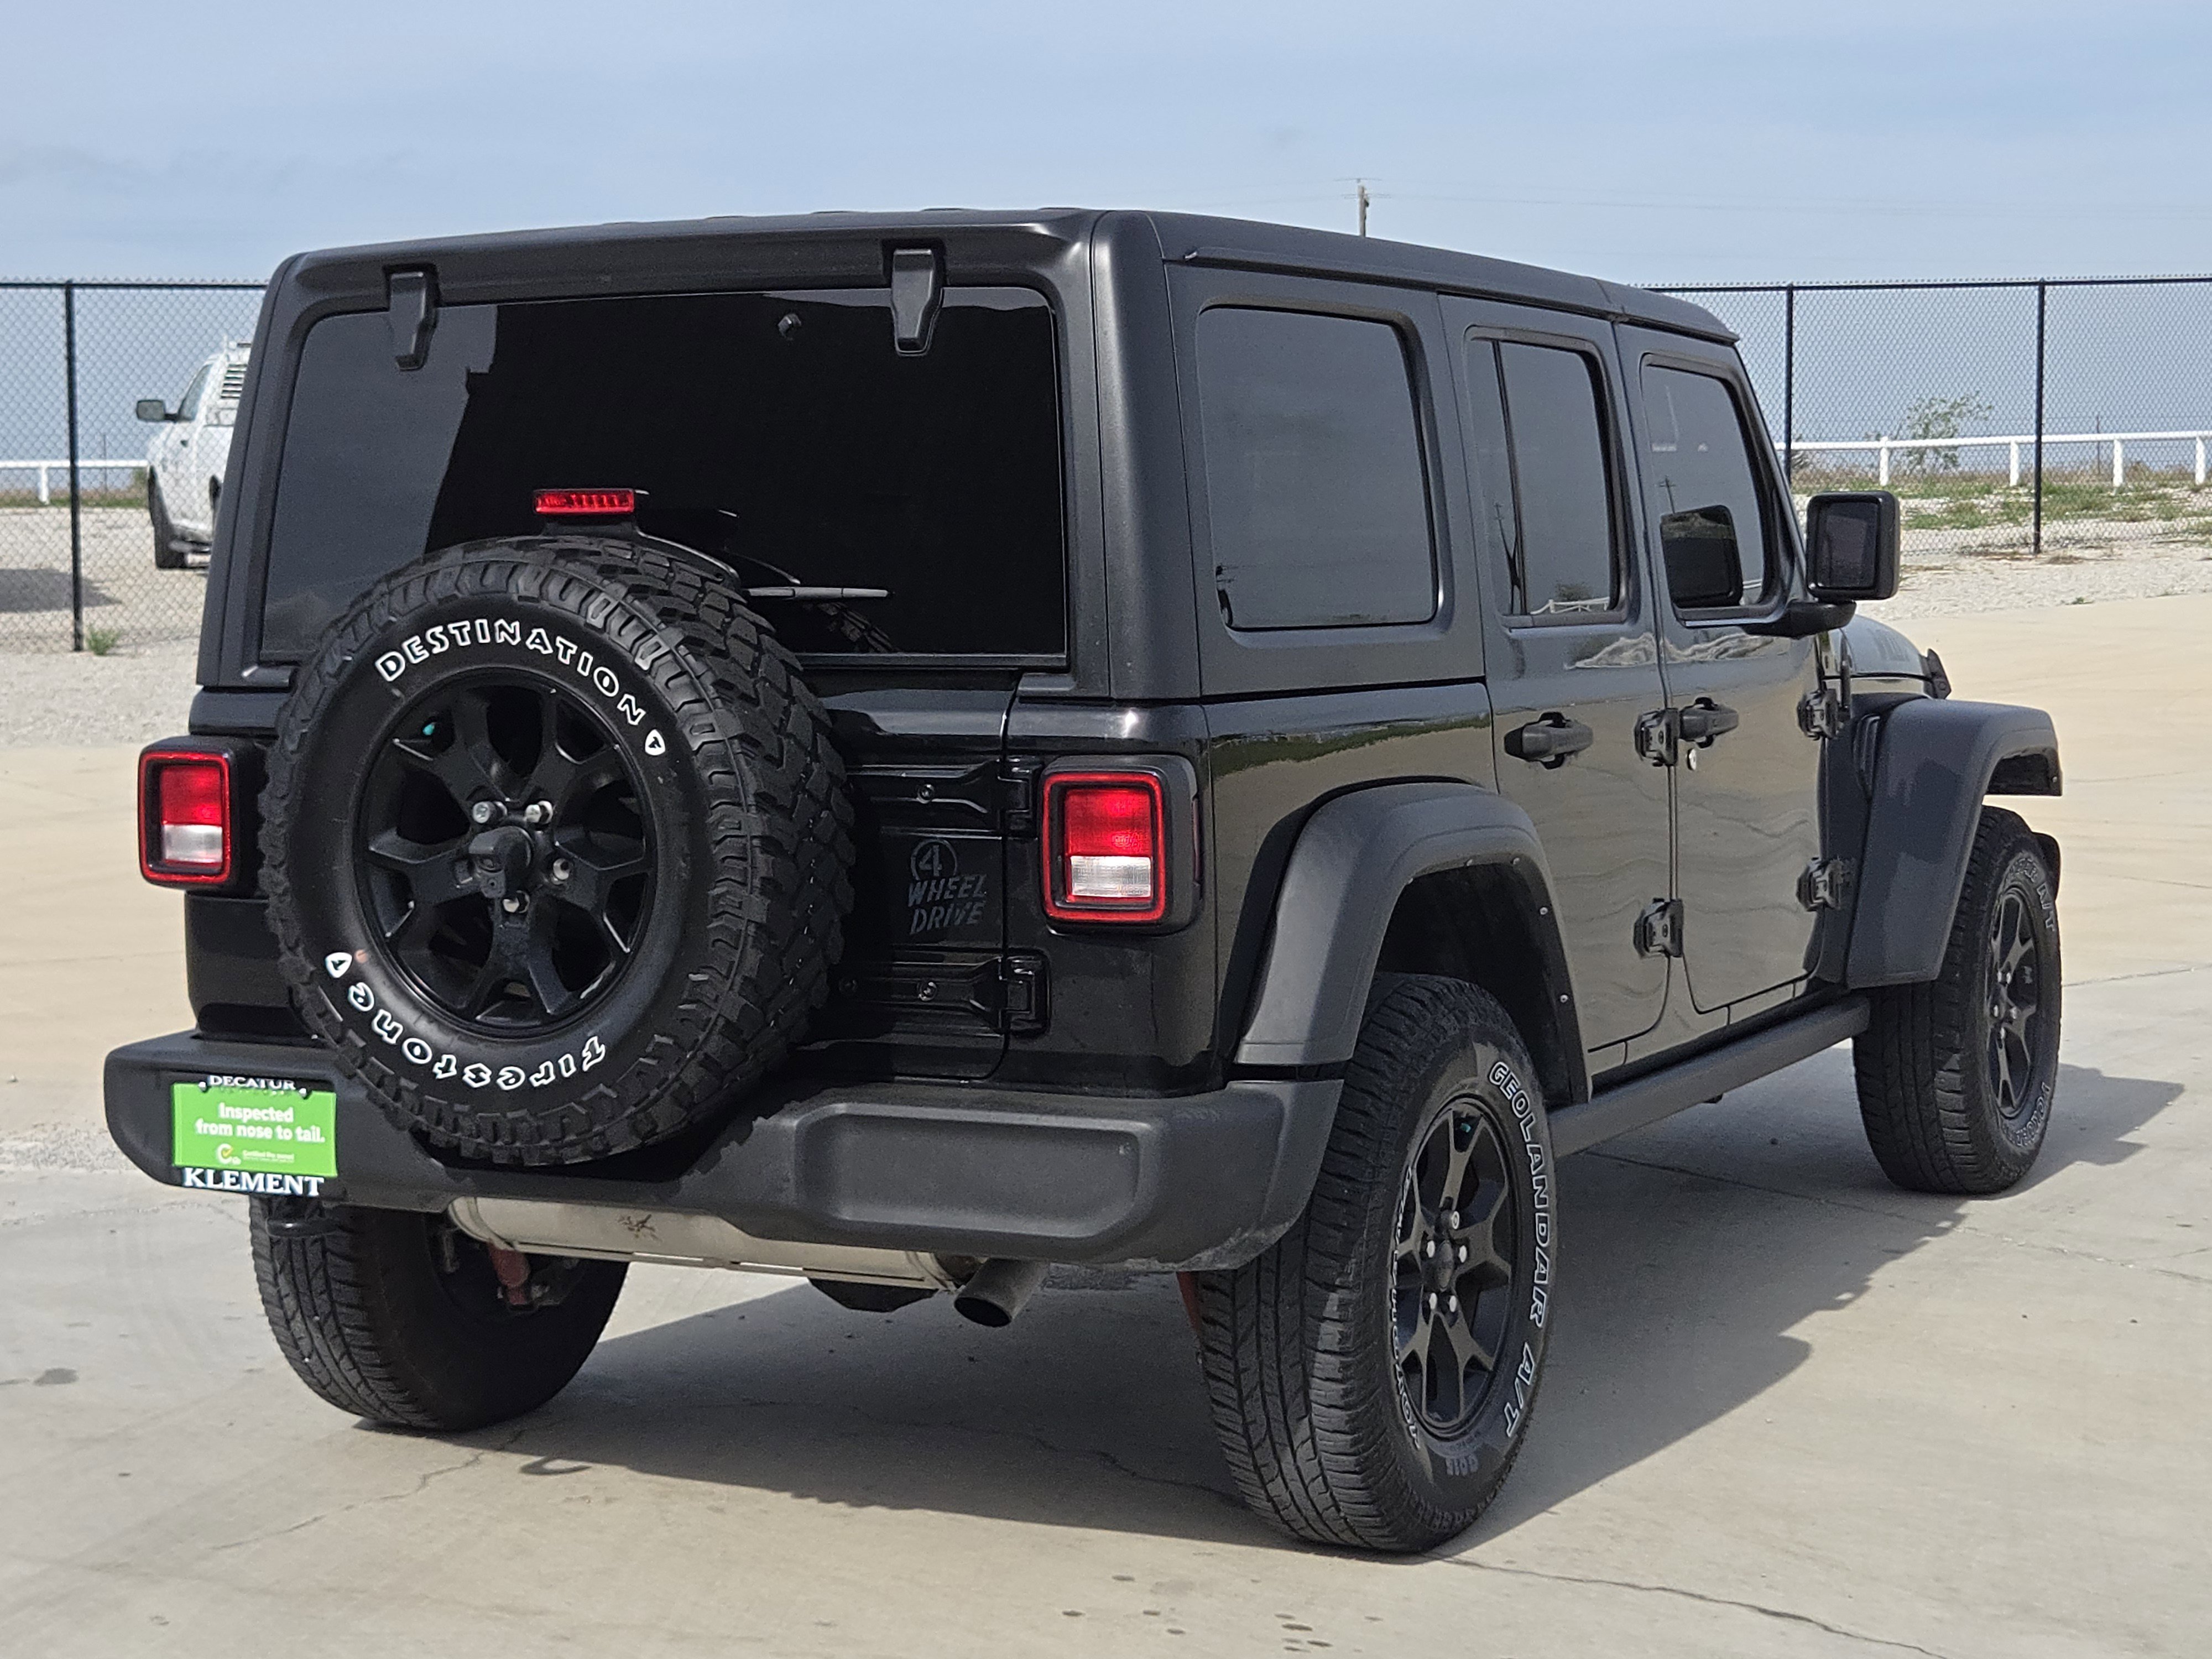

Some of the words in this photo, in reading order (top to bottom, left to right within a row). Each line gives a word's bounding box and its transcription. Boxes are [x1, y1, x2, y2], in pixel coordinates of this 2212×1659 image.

[374, 618, 646, 726] DESTINATION
[918, 844, 943, 877] 4
[908, 874, 987, 907] WHEEL
[909, 901, 987, 935] DRIVE
[208, 1074, 296, 1091] DECATUR
[219, 1102, 294, 1123] Inspected
[195, 1118, 233, 1136] from
[236, 1124, 273, 1139] nose
[275, 1125, 293, 1140] to
[295, 1125, 326, 1143] tail.
[182, 1166, 325, 1198] KLEMENT
[1489, 1061, 1549, 1327] GEOLANDAR
[1504, 1342, 1535, 1437] A/T
